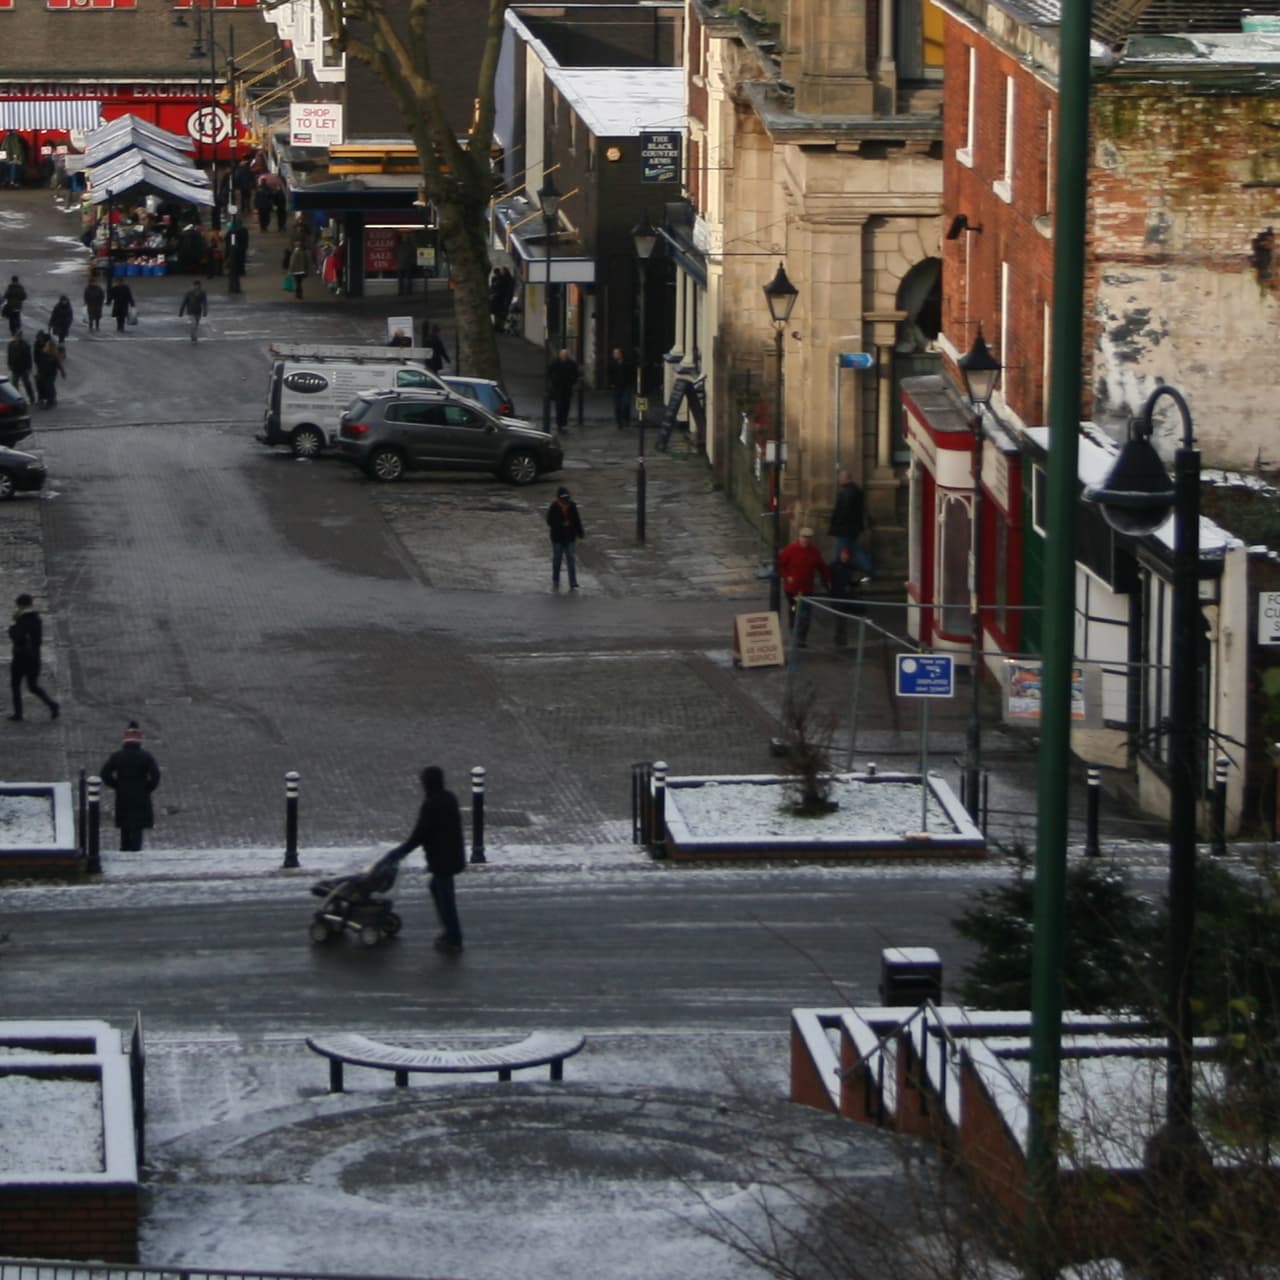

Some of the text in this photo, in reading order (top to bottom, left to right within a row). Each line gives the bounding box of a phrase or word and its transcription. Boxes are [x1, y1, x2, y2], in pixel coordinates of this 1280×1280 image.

[133, 84, 224, 97] EXCHANG
[303, 108, 330, 117] SHOP
[296, 118, 337, 128] TO LET
